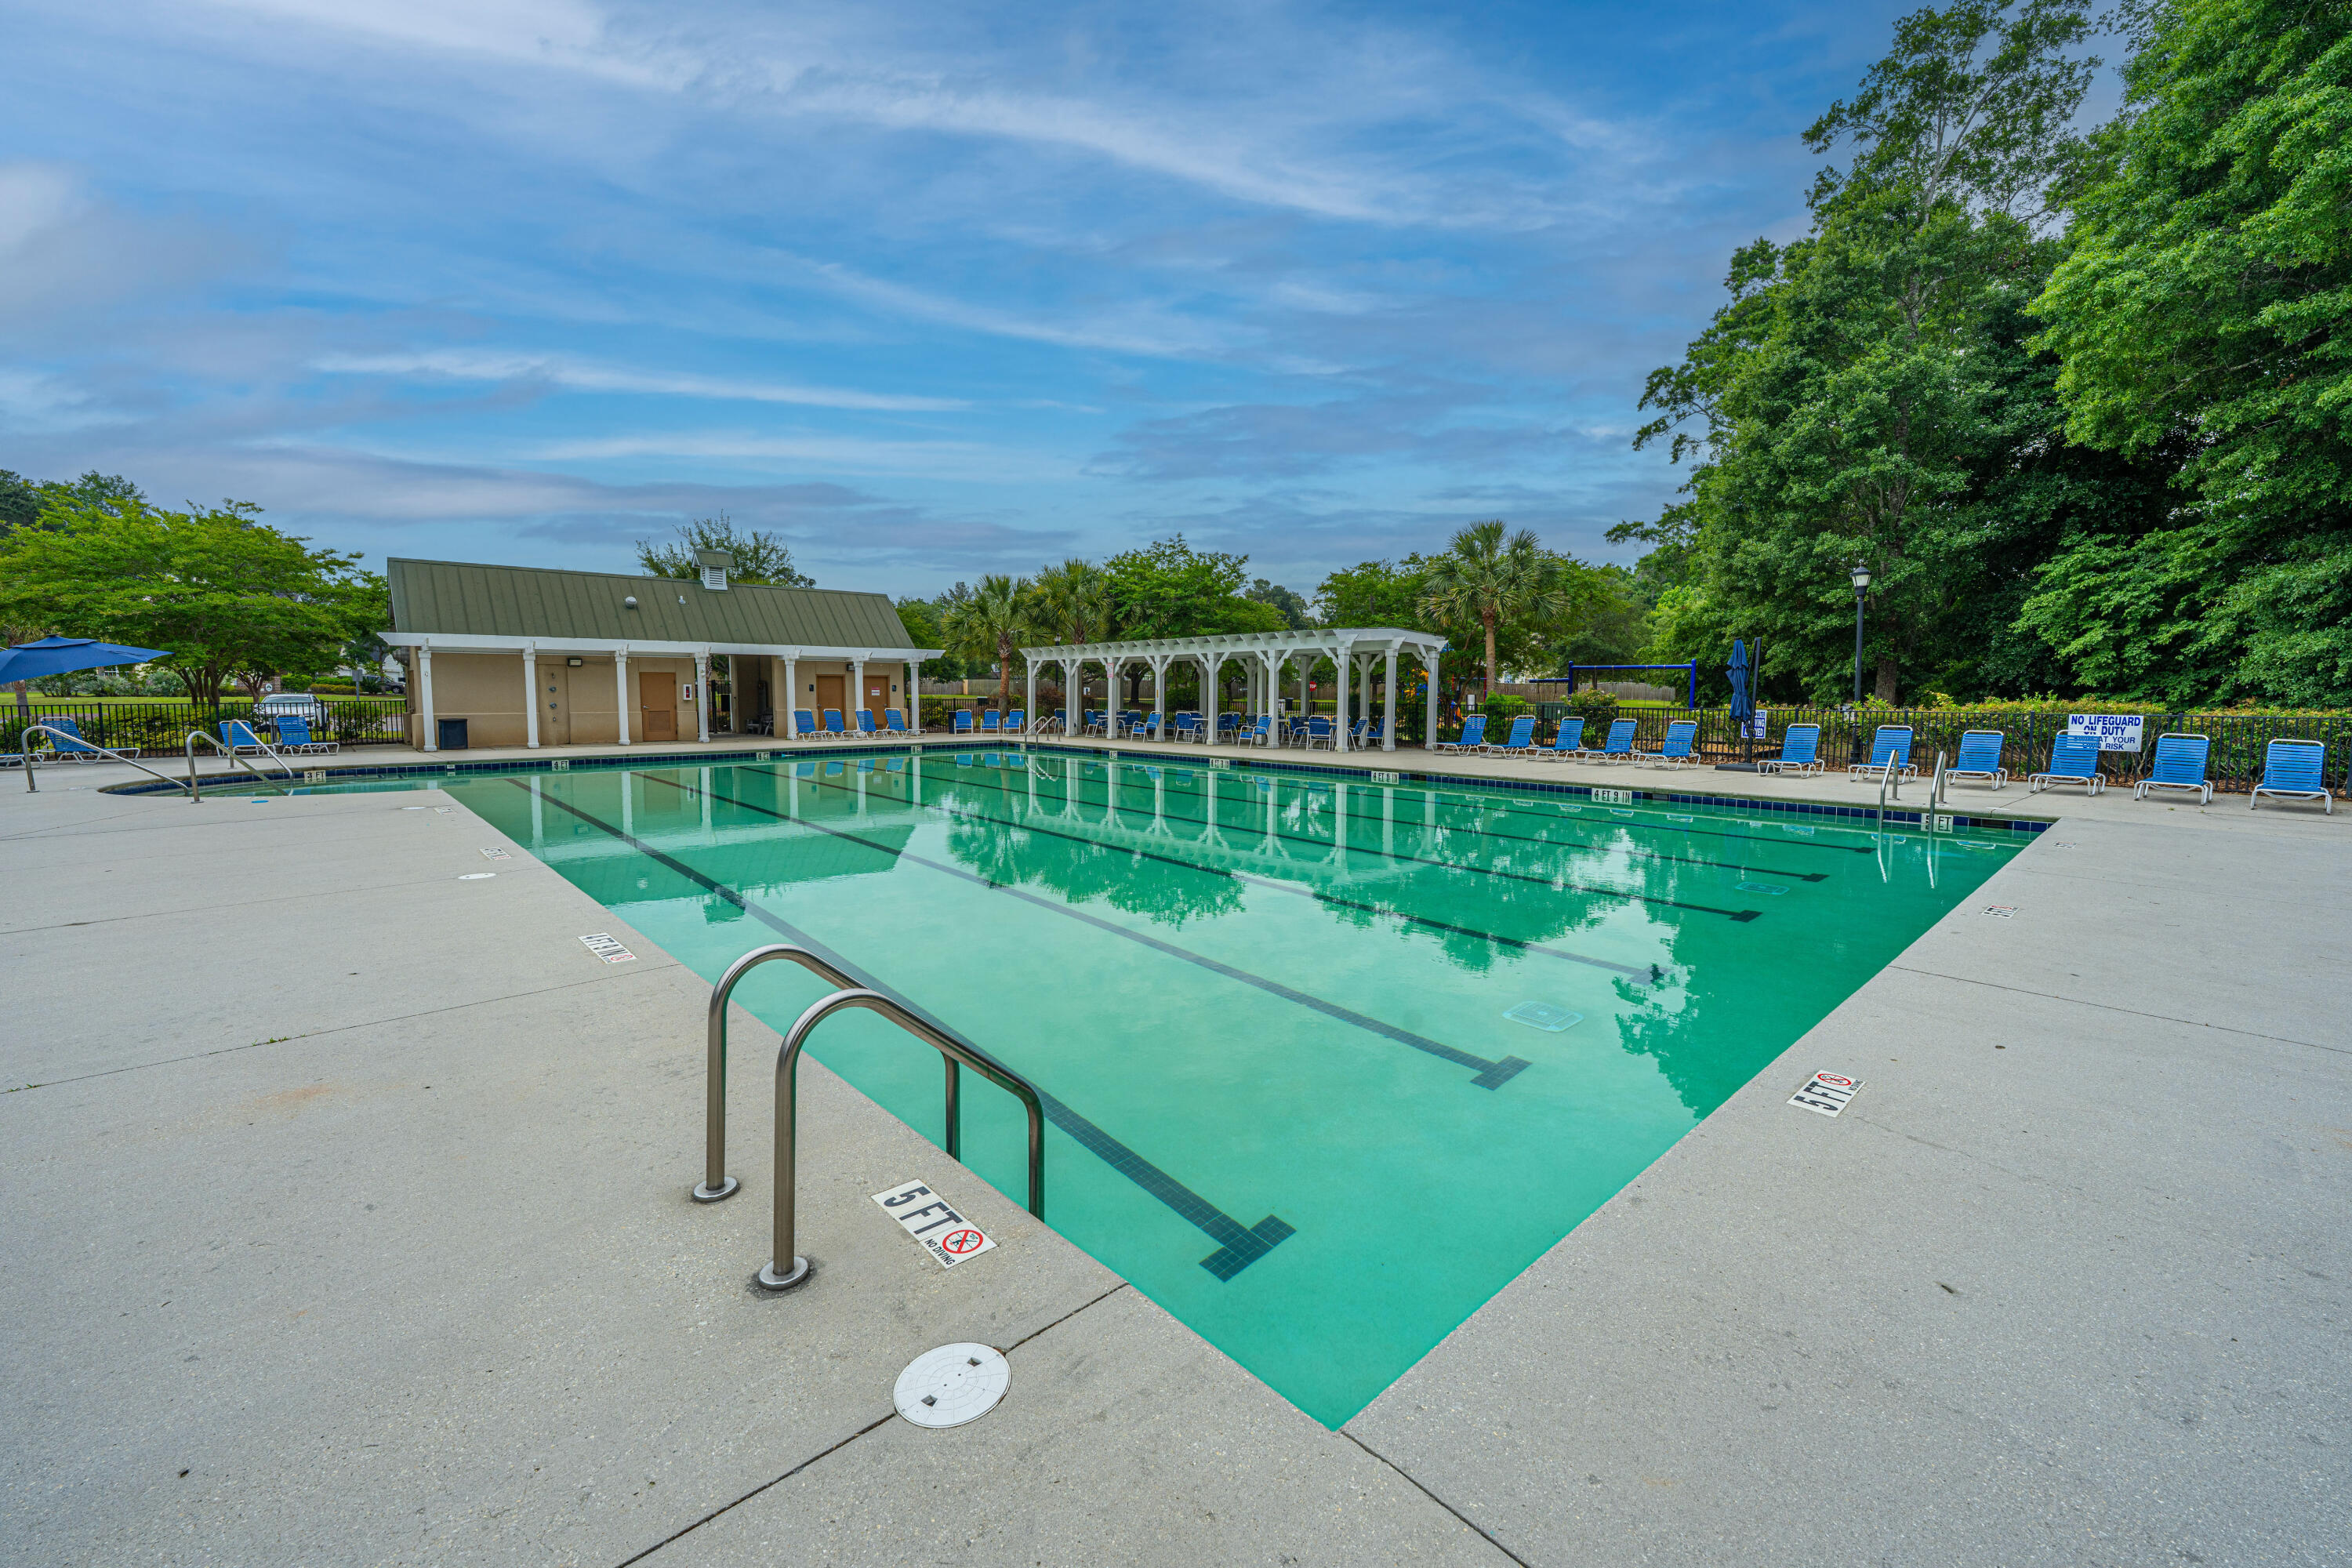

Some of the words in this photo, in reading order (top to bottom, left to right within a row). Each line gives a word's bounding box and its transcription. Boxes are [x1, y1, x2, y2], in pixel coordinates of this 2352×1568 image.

[2071, 716, 2084, 724] NO
[2089, 716, 2140, 726] LIFEGUARD
[2084, 725, 2096, 735] ON
[2101, 726, 2126, 735] DUTY
[1595, 790, 1599, 799] 4
[1803, 1081, 1852, 1102] FT
[1794, 1095, 1838, 1111] 5
[884, 1186, 931, 1207] 5
[898, 1201, 964, 1235] FT
[924, 1239, 937, 1247] NO
[932, 1247, 955, 1265] DIVING
